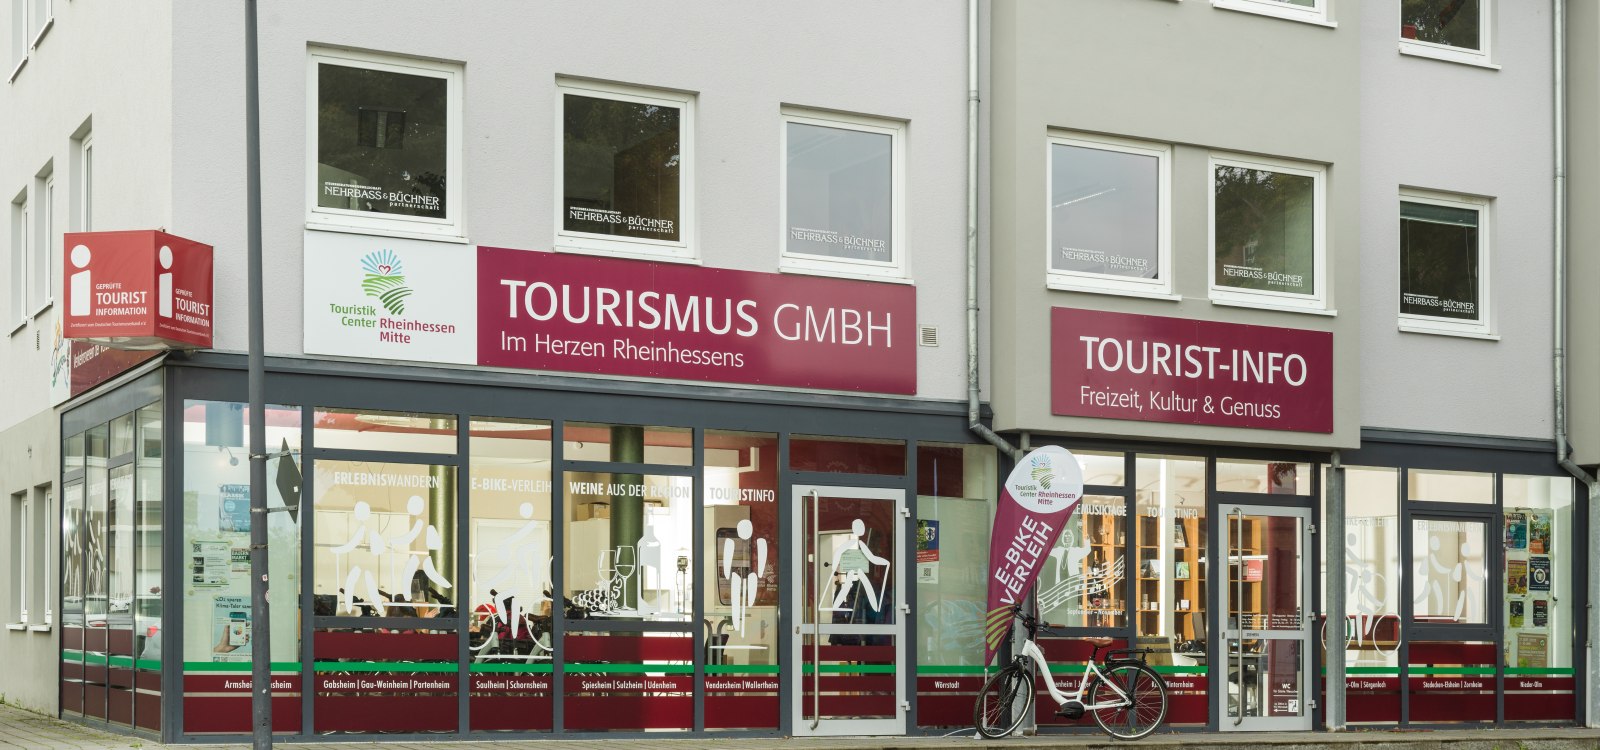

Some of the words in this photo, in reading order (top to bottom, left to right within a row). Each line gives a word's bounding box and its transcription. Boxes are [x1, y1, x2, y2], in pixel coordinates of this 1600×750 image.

[324, 186, 382, 200] NEHRBASS
[390, 191, 439, 206] BÜCHNER
[390, 202, 440, 210] partnerschaft
[570, 210, 621, 224] NEHRBASS
[628, 216, 674, 229] BÜCHNER
[629, 226, 674, 234] partnerschaft
[791, 231, 838, 243] NEHRBASS
[844, 236, 885, 248] BÜCHNER
[1062, 250, 1104, 262] NEHRBASS
[1110, 255, 1148, 267] BÜCHNER
[1224, 268, 1262, 279] NEHRBASS
[1268, 272, 1302, 283] BÜCHNER
[96, 282, 122, 290] GEPRÜFTE
[176, 288, 192, 298] GEPRÜFTE
[96, 291, 147, 304] TOURIST
[1404, 296, 1438, 307] NEHRBASS
[1443, 299, 1474, 310] BÜCHNER
[96, 307, 147, 316] INFORMATION
[176, 298, 209, 316] TOURIST
[330, 303, 376, 317] Touristik
[500, 280, 758, 337] TOURISMUS
[773, 303, 892, 348] GMBH
[176, 313, 209, 327] INFORMATION
[341, 316, 376, 328] Center
[380, 318, 455, 334] Rheinhessen
[380, 331, 411, 344] Mitte
[501, 330, 526, 352] Im
[535, 334, 605, 358] Herzen
[613, 338, 744, 368] Rheinhessens
[1080, 335, 1307, 387] TOURIST-INFO
[1080, 385, 1142, 412] Freizeit,
[1150, 390, 1197, 413] Kultur
[1203, 396, 1215, 414] &
[1221, 396, 1281, 419] Genuss
[334, 472, 440, 488] ERLEBNISWANDERN
[472, 477, 552, 493] E-BIKE-VERLEIH
[570, 481, 603, 495] WEINE
[606, 483, 626, 497] AUS
[628, 484, 646, 497] DER
[651, 485, 690, 498] REGION
[710, 487, 774, 502] TOURISTINFO
[1038, 491, 1076, 499] Rheinhessen
[994, 515, 1038, 586] E-BIKE
[1000, 521, 1054, 605] VERLEIH
[224, 680, 252, 688] Armshei
[271, 680, 292, 688] sheim
[323, 680, 356, 689] Gabsheim
[361, 680, 408, 689] Gau-Weinheim
[413, 680, 450, 689] Partenheim
[476, 681, 505, 689] Saulheim
[510, 681, 548, 689] Schornsheim
[582, 681, 611, 690] Spiesheim
[616, 681, 643, 689] Sulzheim
[648, 681, 676, 689] Udenheim
[705, 681, 741, 689] Vendersheim
[745, 681, 778, 689] Wallertheim
[935, 680, 960, 689] Wörrstadt
[1363, 681, 1386, 689] Sörgenloch
[1520, 681, 1543, 689] Nieder-Olm
